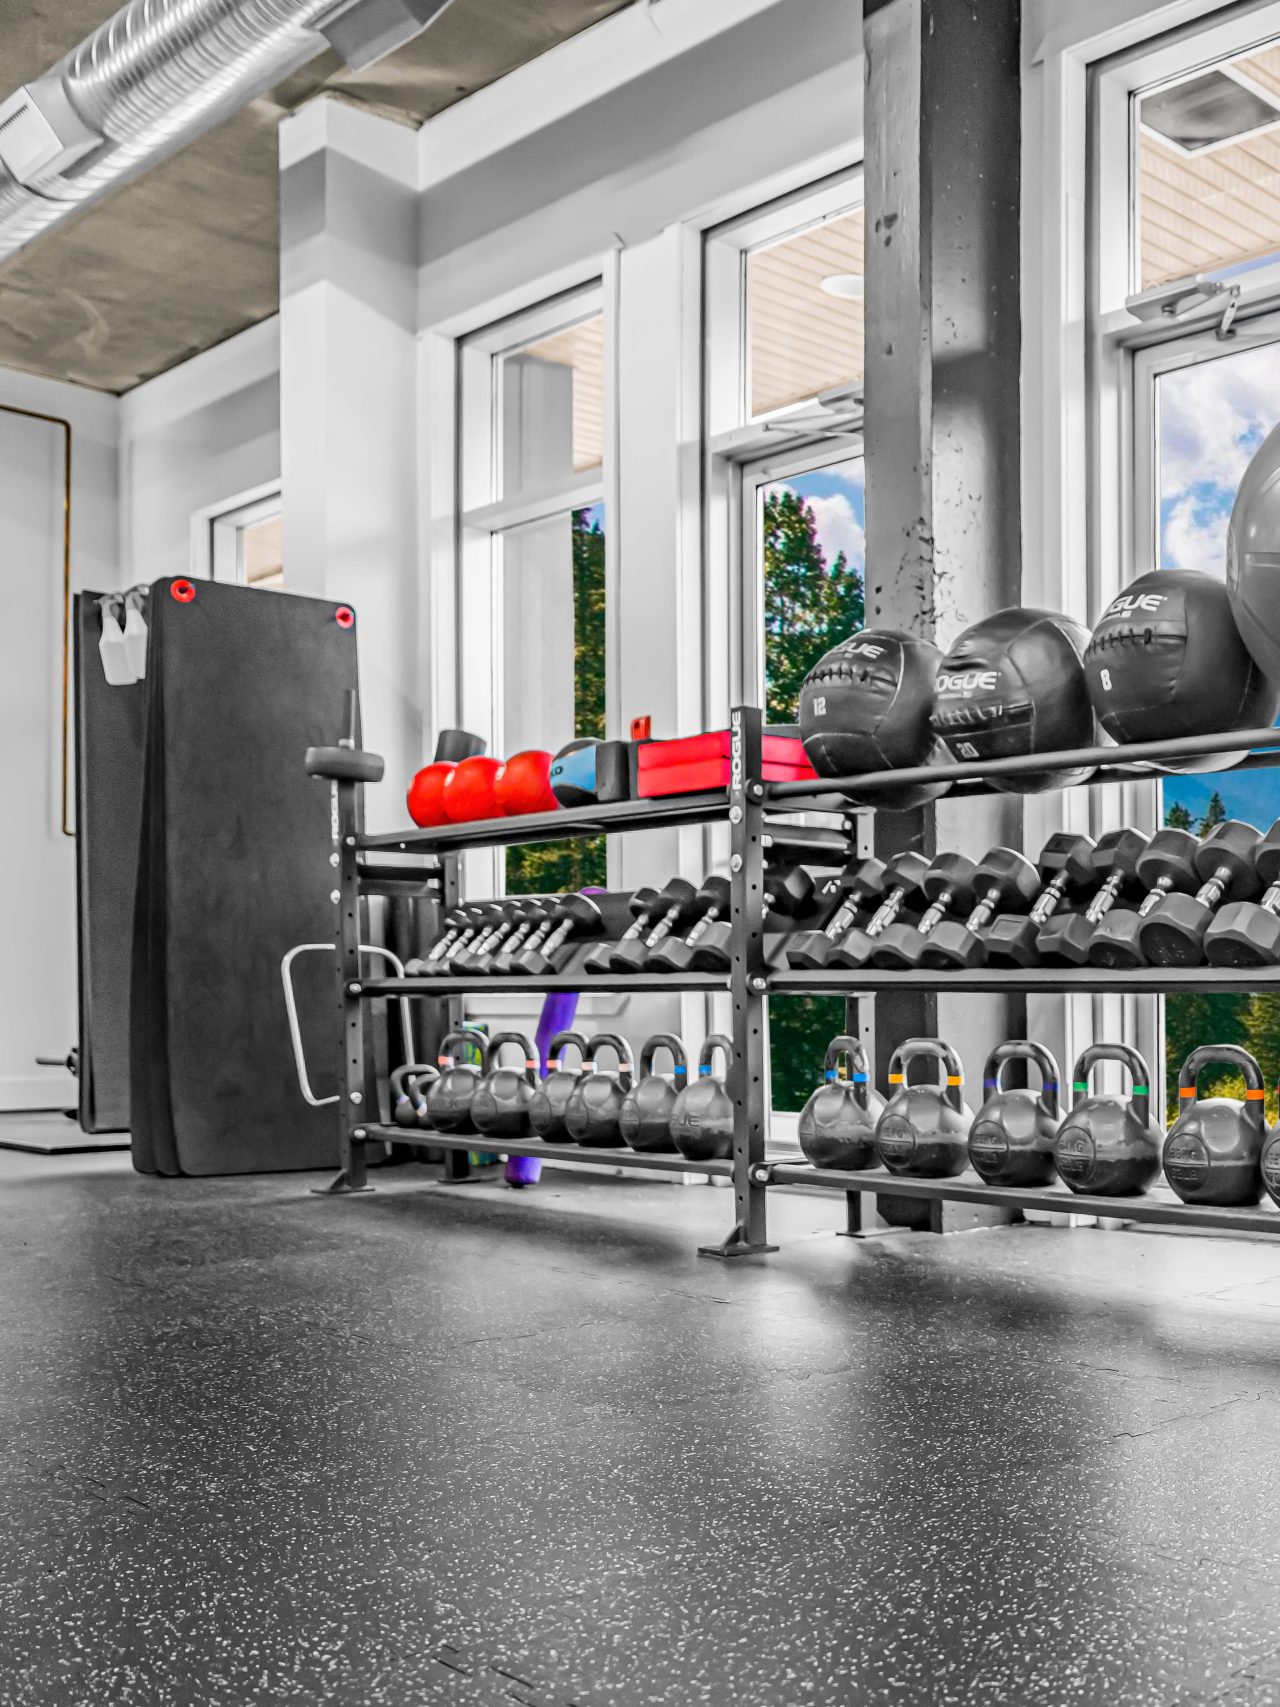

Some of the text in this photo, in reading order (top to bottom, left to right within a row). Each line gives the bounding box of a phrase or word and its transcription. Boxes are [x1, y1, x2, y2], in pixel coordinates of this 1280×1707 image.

[1108, 594, 1164, 613] GUE
[933, 671, 998, 692] OGUE
[1100, 669, 1112, 691] 8
[813, 697, 826, 716] 12
[731, 711, 742, 790] ROGUE
[956, 742, 979, 758] 20
